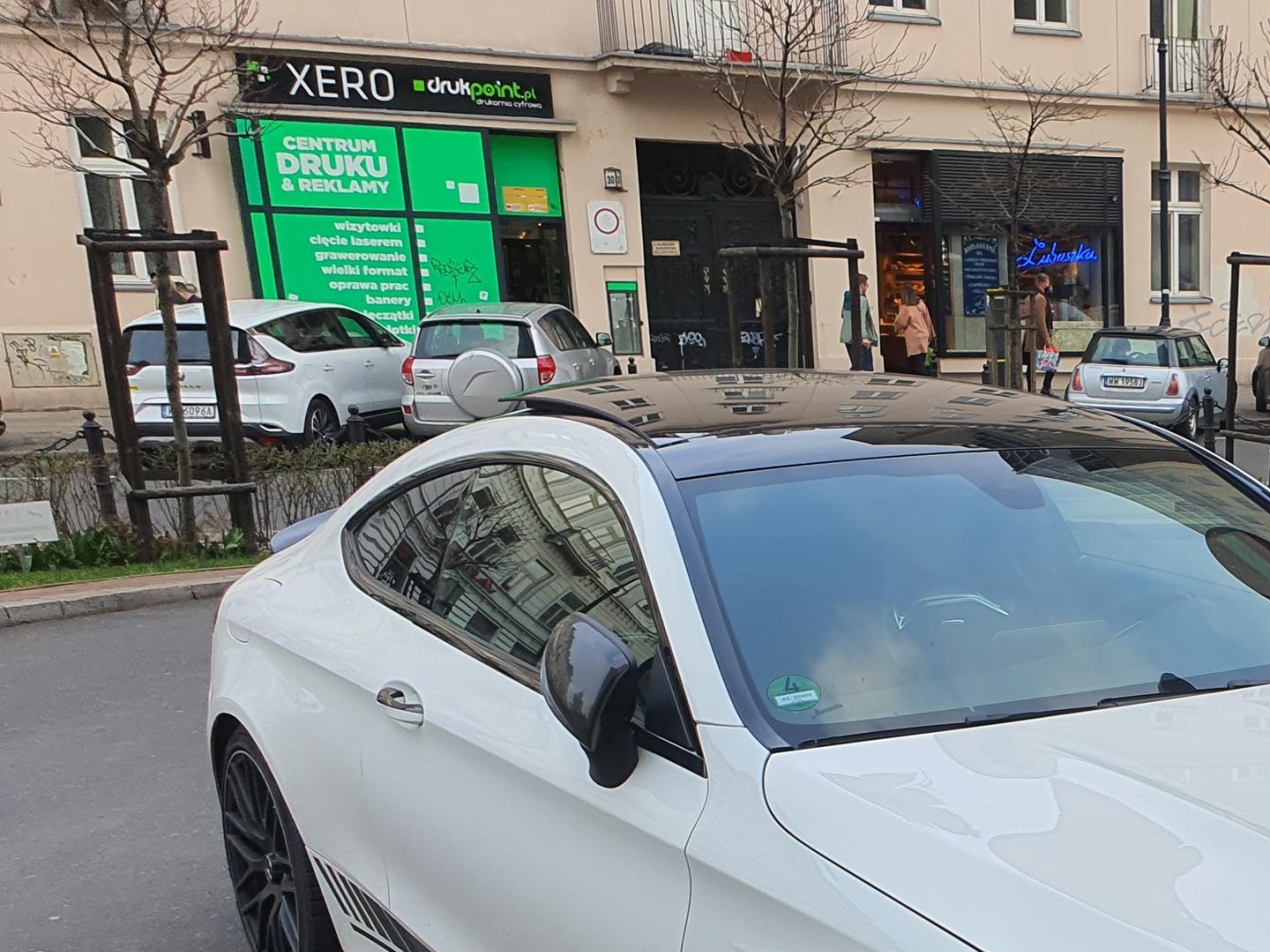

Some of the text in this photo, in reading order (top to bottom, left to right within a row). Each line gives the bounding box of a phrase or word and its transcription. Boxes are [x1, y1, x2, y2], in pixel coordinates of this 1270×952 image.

[286, 63, 395, 102] XERO
[427, 77, 537, 102] drukpoint.pl
[475, 98, 512, 108] drukarnia
[282, 136, 377, 153] CENTRUM
[275, 152, 388, 178] DRUKU
[281, 178, 389, 195] & REKLAMY
[309, 234, 403, 248] cięcie laserem
[314, 249, 407, 263] grawerowanie
[321, 264, 408, 277] wielki format
[329, 279, 409, 293] oprawa prac
[365, 294, 411, 307] banery
